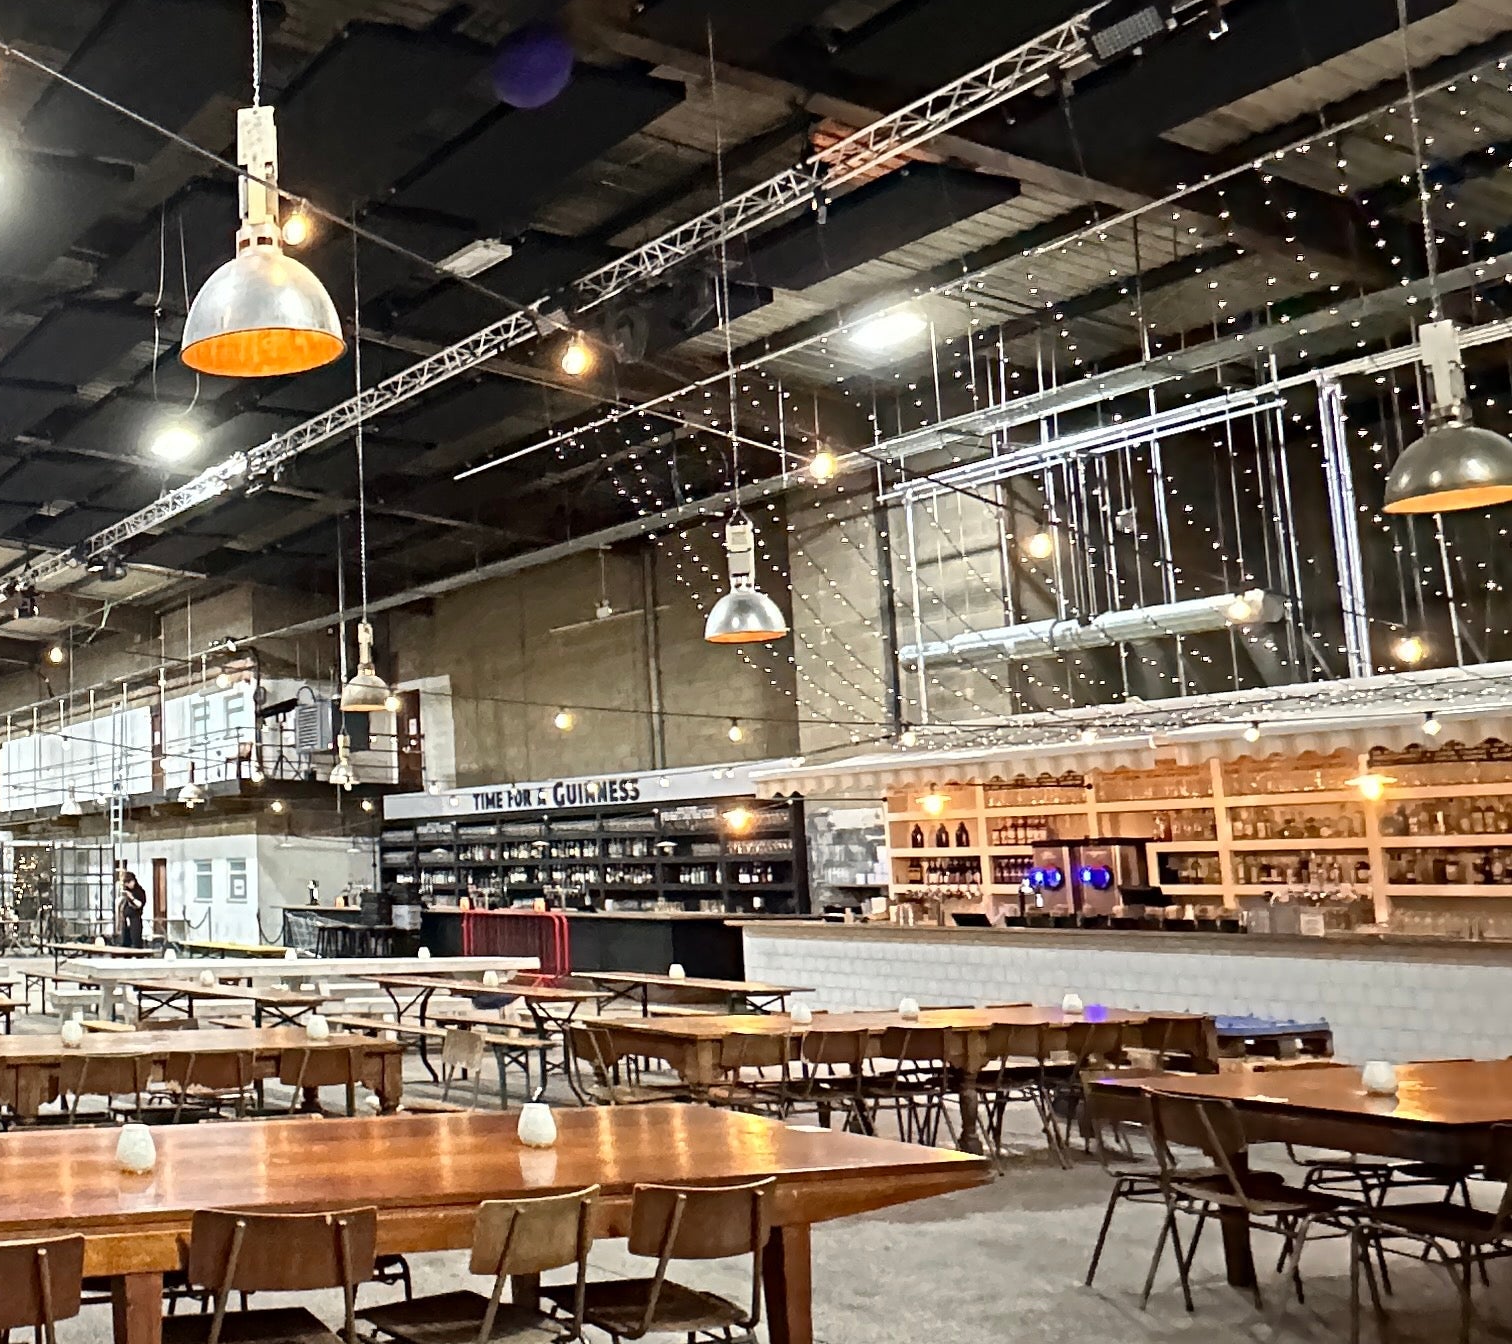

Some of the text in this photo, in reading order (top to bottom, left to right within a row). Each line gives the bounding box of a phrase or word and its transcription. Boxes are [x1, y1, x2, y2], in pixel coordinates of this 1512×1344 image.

[472, 791, 504, 811] TIME
[507, 789, 532, 807] FOR
[553, 779, 640, 807] GUINNESS
